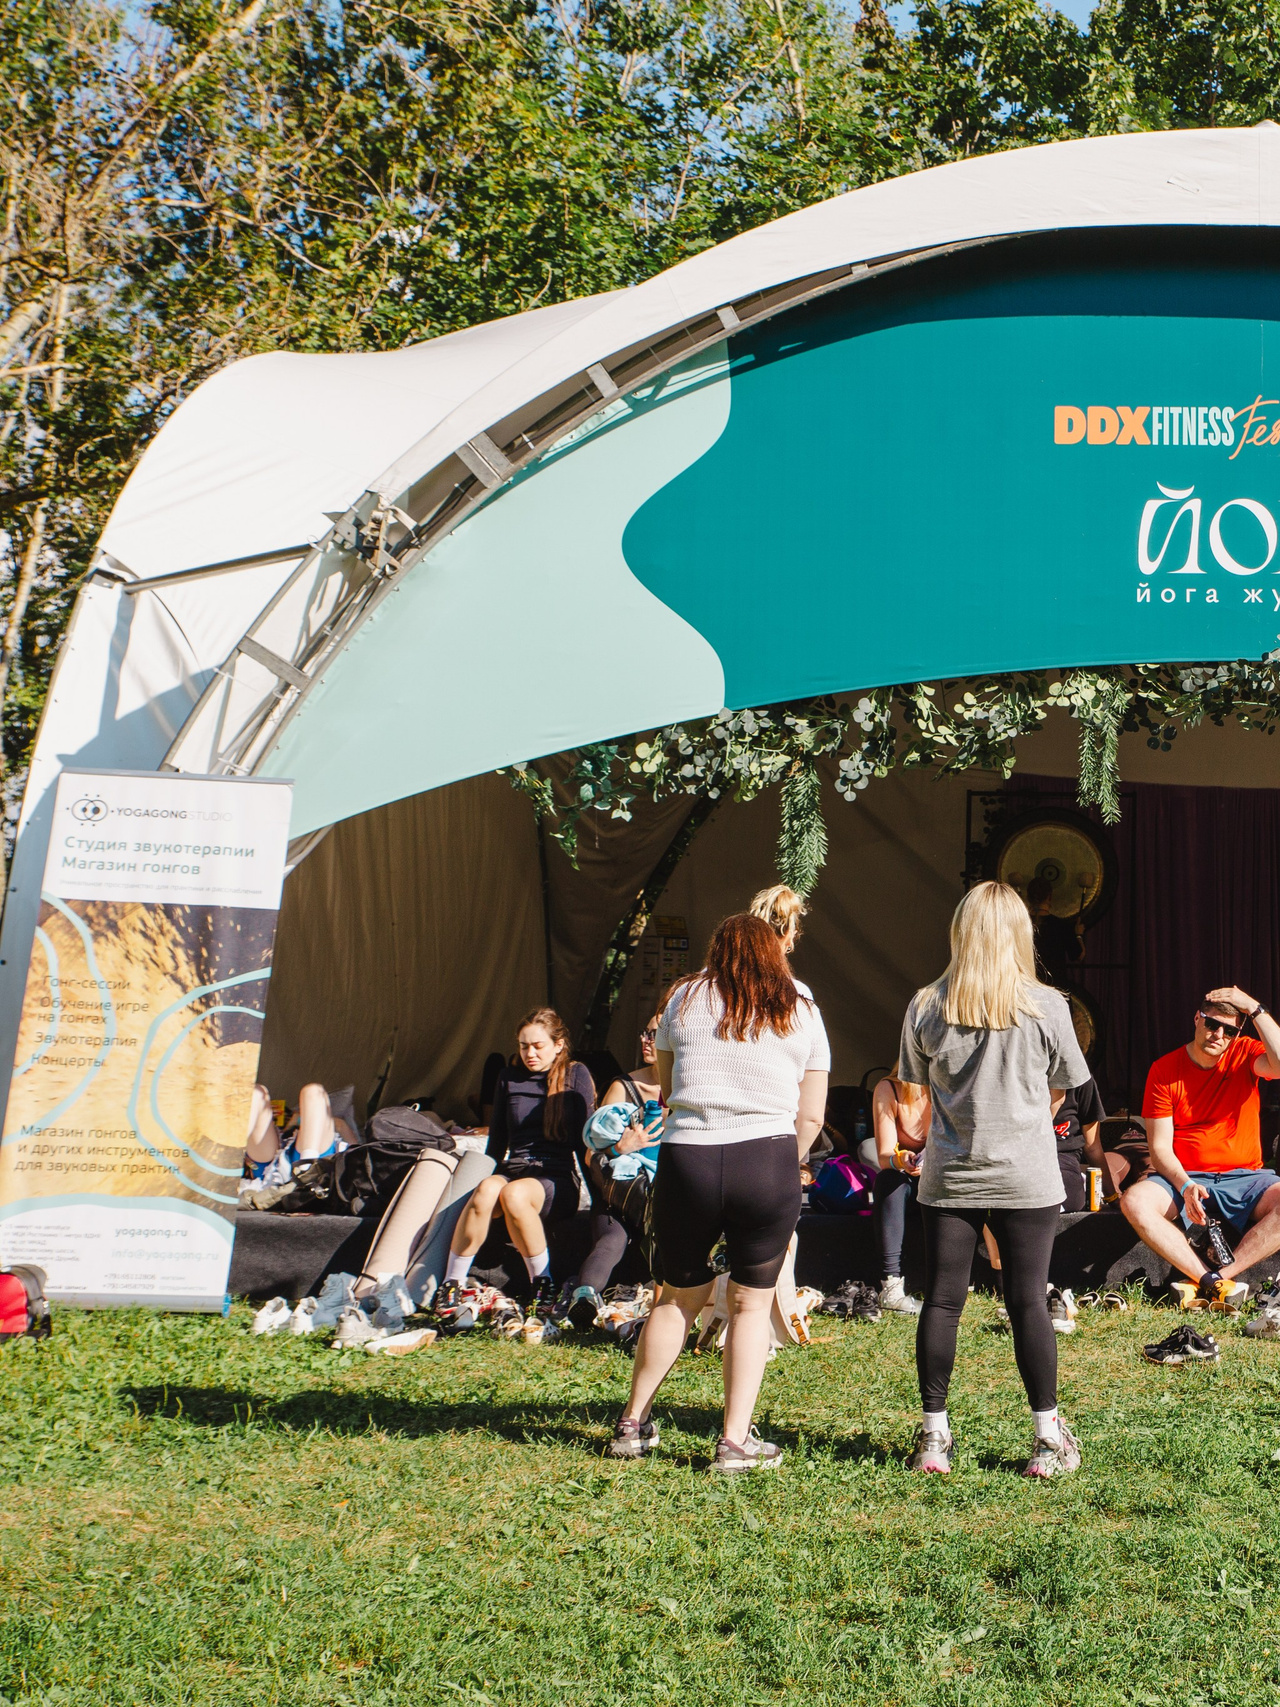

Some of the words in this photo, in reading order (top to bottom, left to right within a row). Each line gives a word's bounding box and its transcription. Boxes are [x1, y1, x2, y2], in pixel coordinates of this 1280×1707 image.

[1054, 405, 1151, 445] DDX
[1152, 406, 1235, 446] FITNESS
[1136, 582, 1219, 604] йога
[64, 836, 127, 853] Студия
[133, 841, 255, 858] звукотерапии
[61, 856, 137, 873] Магазин
[142, 861, 201, 876] гонгов
[42, 975, 131, 991] Гонг-сессии
[40, 996, 112, 1013] Обучение
[116, 1001, 150, 1014] игре
[37, 1013, 54, 1024] на
[60, 1014, 108, 1026] гонгах
[33, 1032, 138, 1049] Звукотерапия
[31, 1053, 105, 1069] Концерты
[20, 1125, 83, 1139] Магазин
[88, 1128, 138, 1140] гонгов
[18, 1143, 27, 1153] и
[30, 1143, 83, 1158] других
[87, 1145, 190, 1159] инструментов
[13, 1161, 43, 1173] для
[46, 1161, 116, 1174] звуковых
[120, 1164, 181, 1176] практик
[114, 1227, 188, 1239] yogagong.ru
[111, 1248, 219, 1262] info@yogagong.ru
